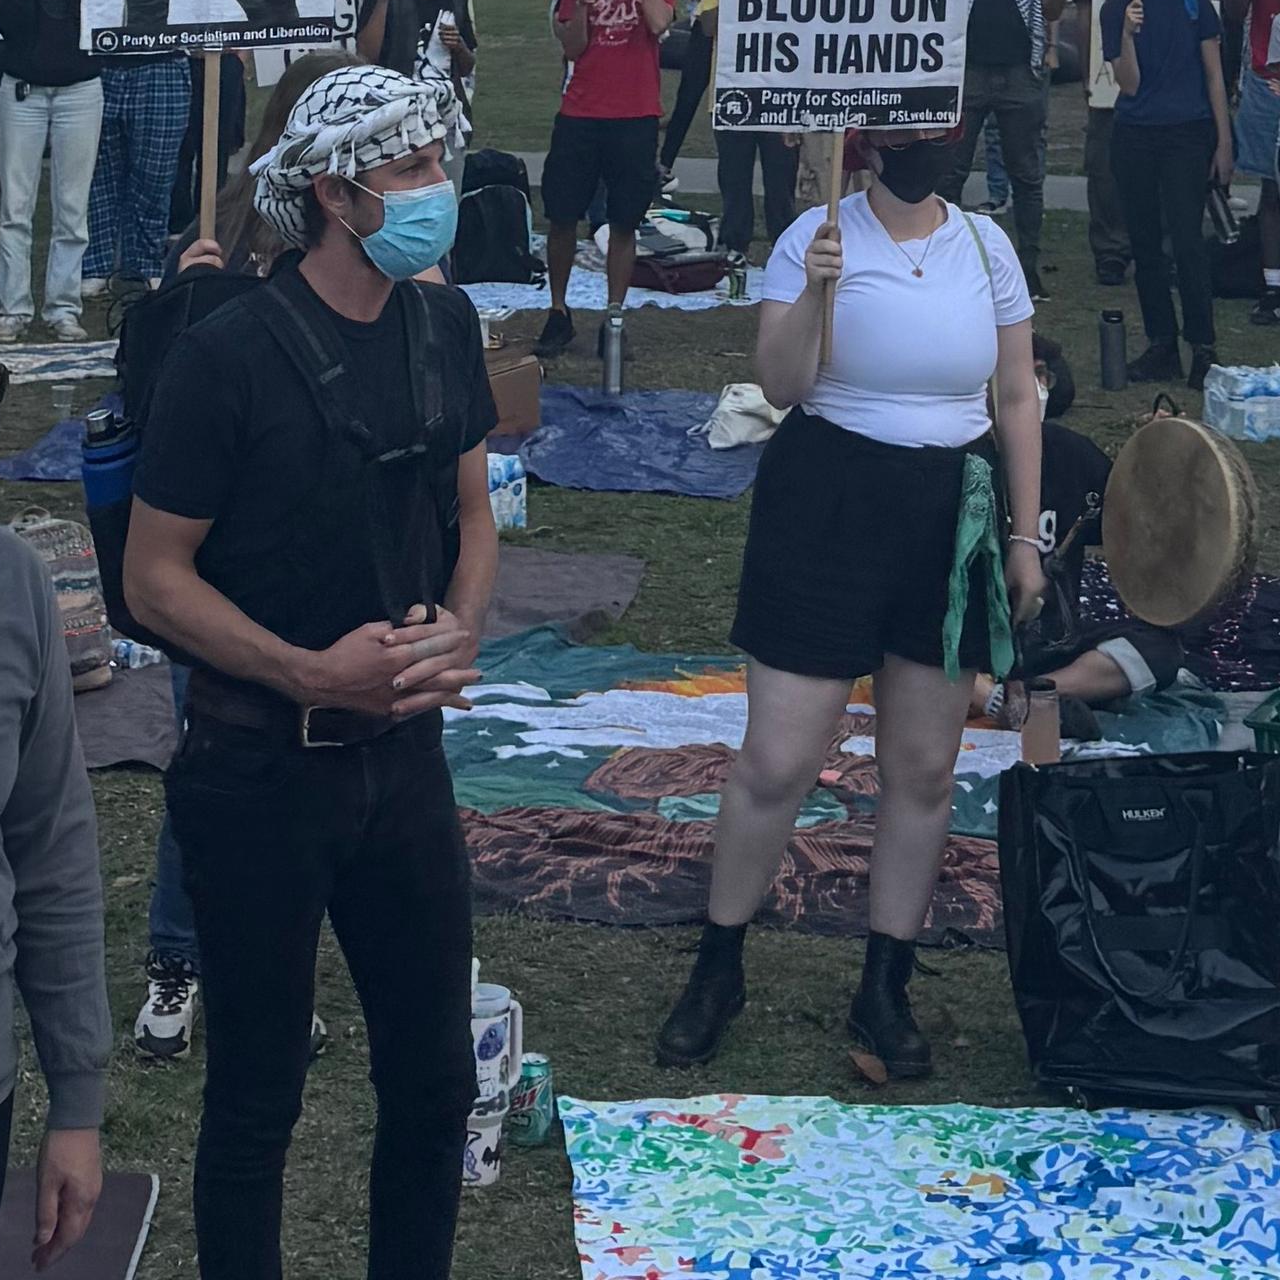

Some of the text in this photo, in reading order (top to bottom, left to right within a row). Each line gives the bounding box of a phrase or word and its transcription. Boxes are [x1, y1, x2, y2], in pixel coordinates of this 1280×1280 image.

[122, 26, 329, 47] Party for Socialism and Liberation
[734, 32, 944, 75] HIS HANDS
[761, 90, 902, 108] Party for Socialism
[760, 110, 788, 123] and
